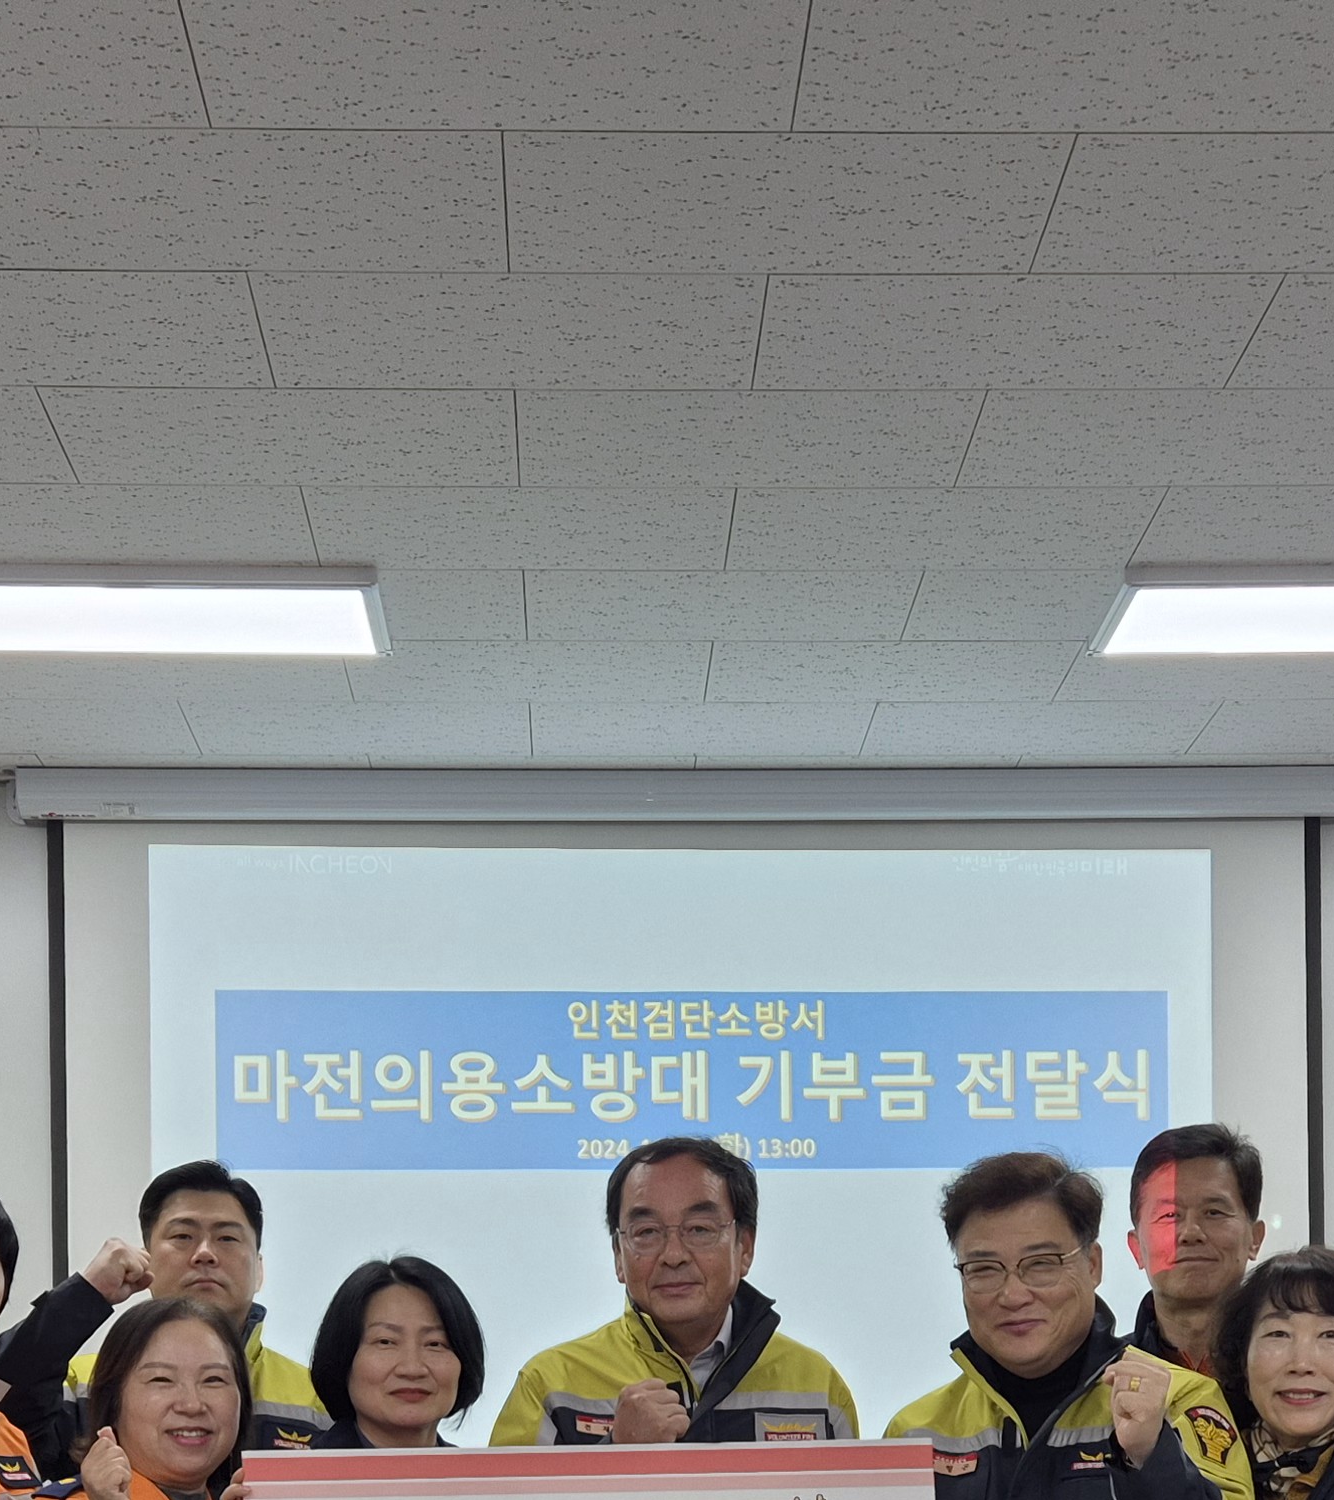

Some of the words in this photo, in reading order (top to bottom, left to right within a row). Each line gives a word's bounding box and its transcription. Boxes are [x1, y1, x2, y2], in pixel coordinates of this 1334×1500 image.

[288, 854, 392, 875] INCHEON
[568, 1000, 826, 1041] 인천검단소방서
[234, 1049, 710, 1124] 마전의용소방대
[737, 1049, 937, 1123] 기부금
[957, 1049, 1151, 1121] 전달식
[758, 1138, 817, 1159] 13:00
